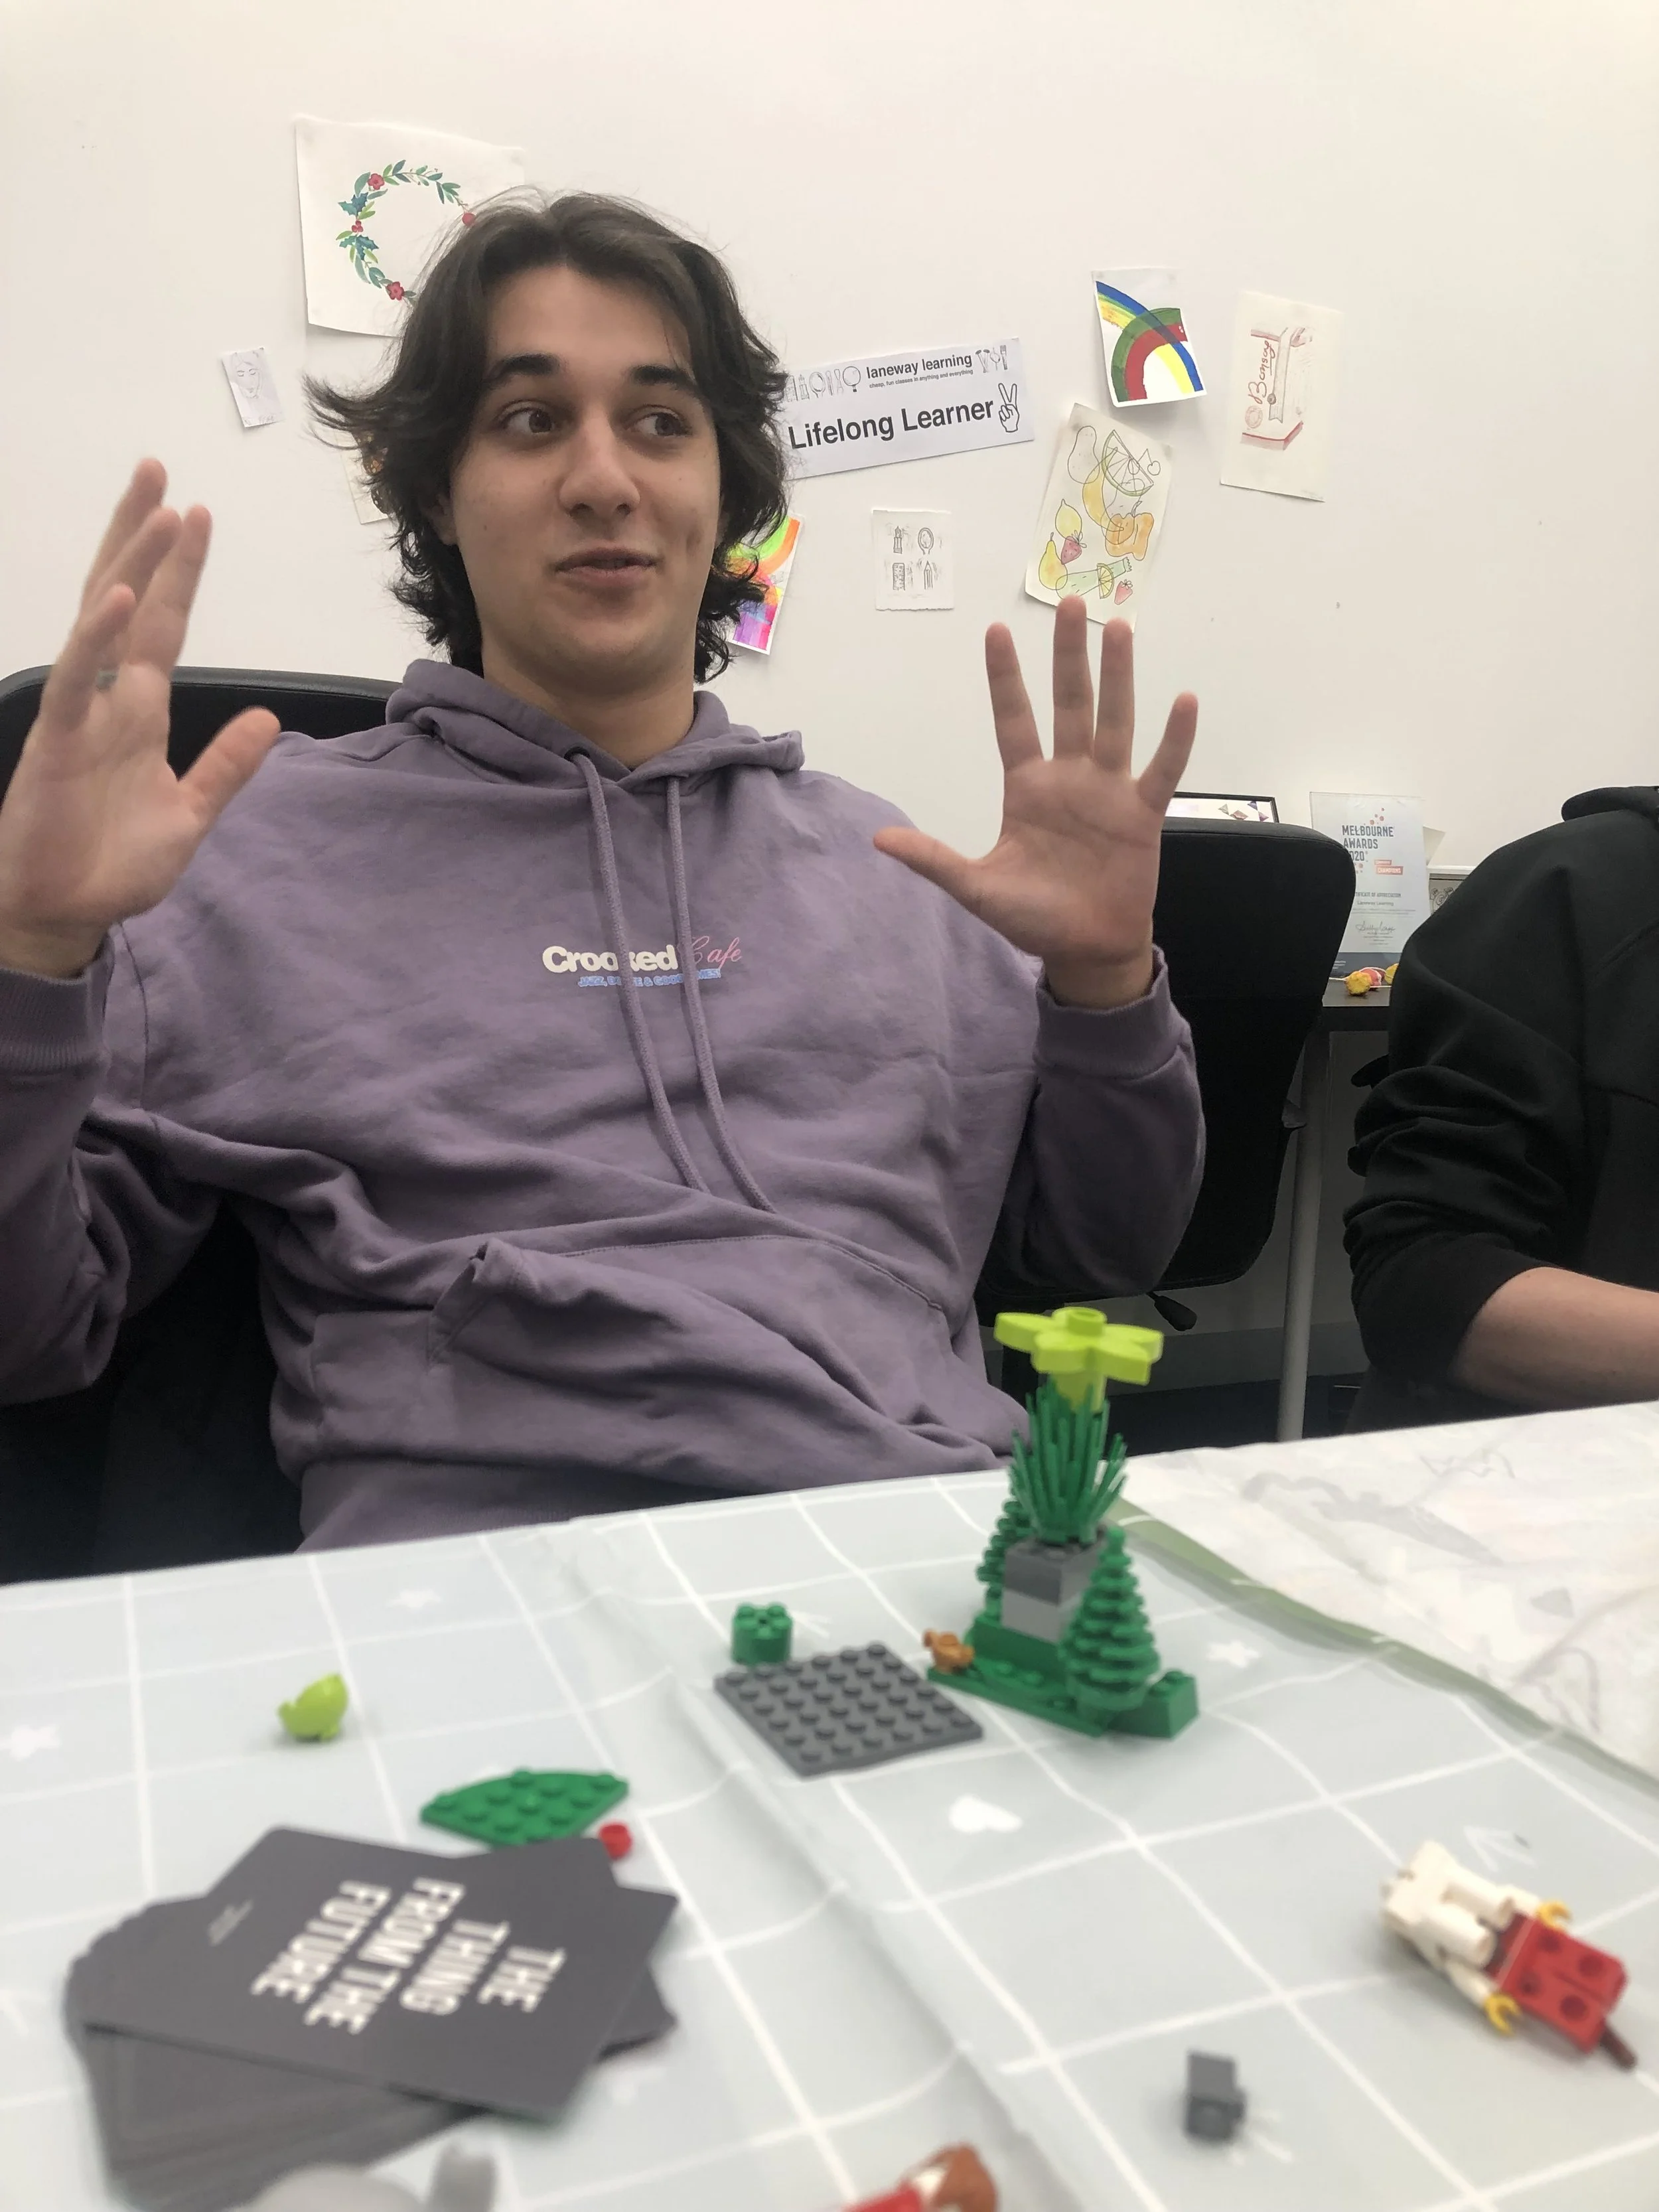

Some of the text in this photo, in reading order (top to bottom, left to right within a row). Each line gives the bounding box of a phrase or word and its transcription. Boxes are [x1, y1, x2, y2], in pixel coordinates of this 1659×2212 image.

[866, 354, 972, 379] laneway learning
[788, 400, 994, 450] Lifelong Learner
[1342, 825, 1394, 838] MELBOURNE
[1344, 838, 1378, 849] AWARDS
[1348, 850, 1365, 861] 020
[644, 976, 653, 987] &
[250, 1880, 392, 2004] FUTURE
[303, 1876, 466, 2035] FROM THE
[399, 1919, 510, 2016] THING
[476, 1946, 567, 2013] THE
